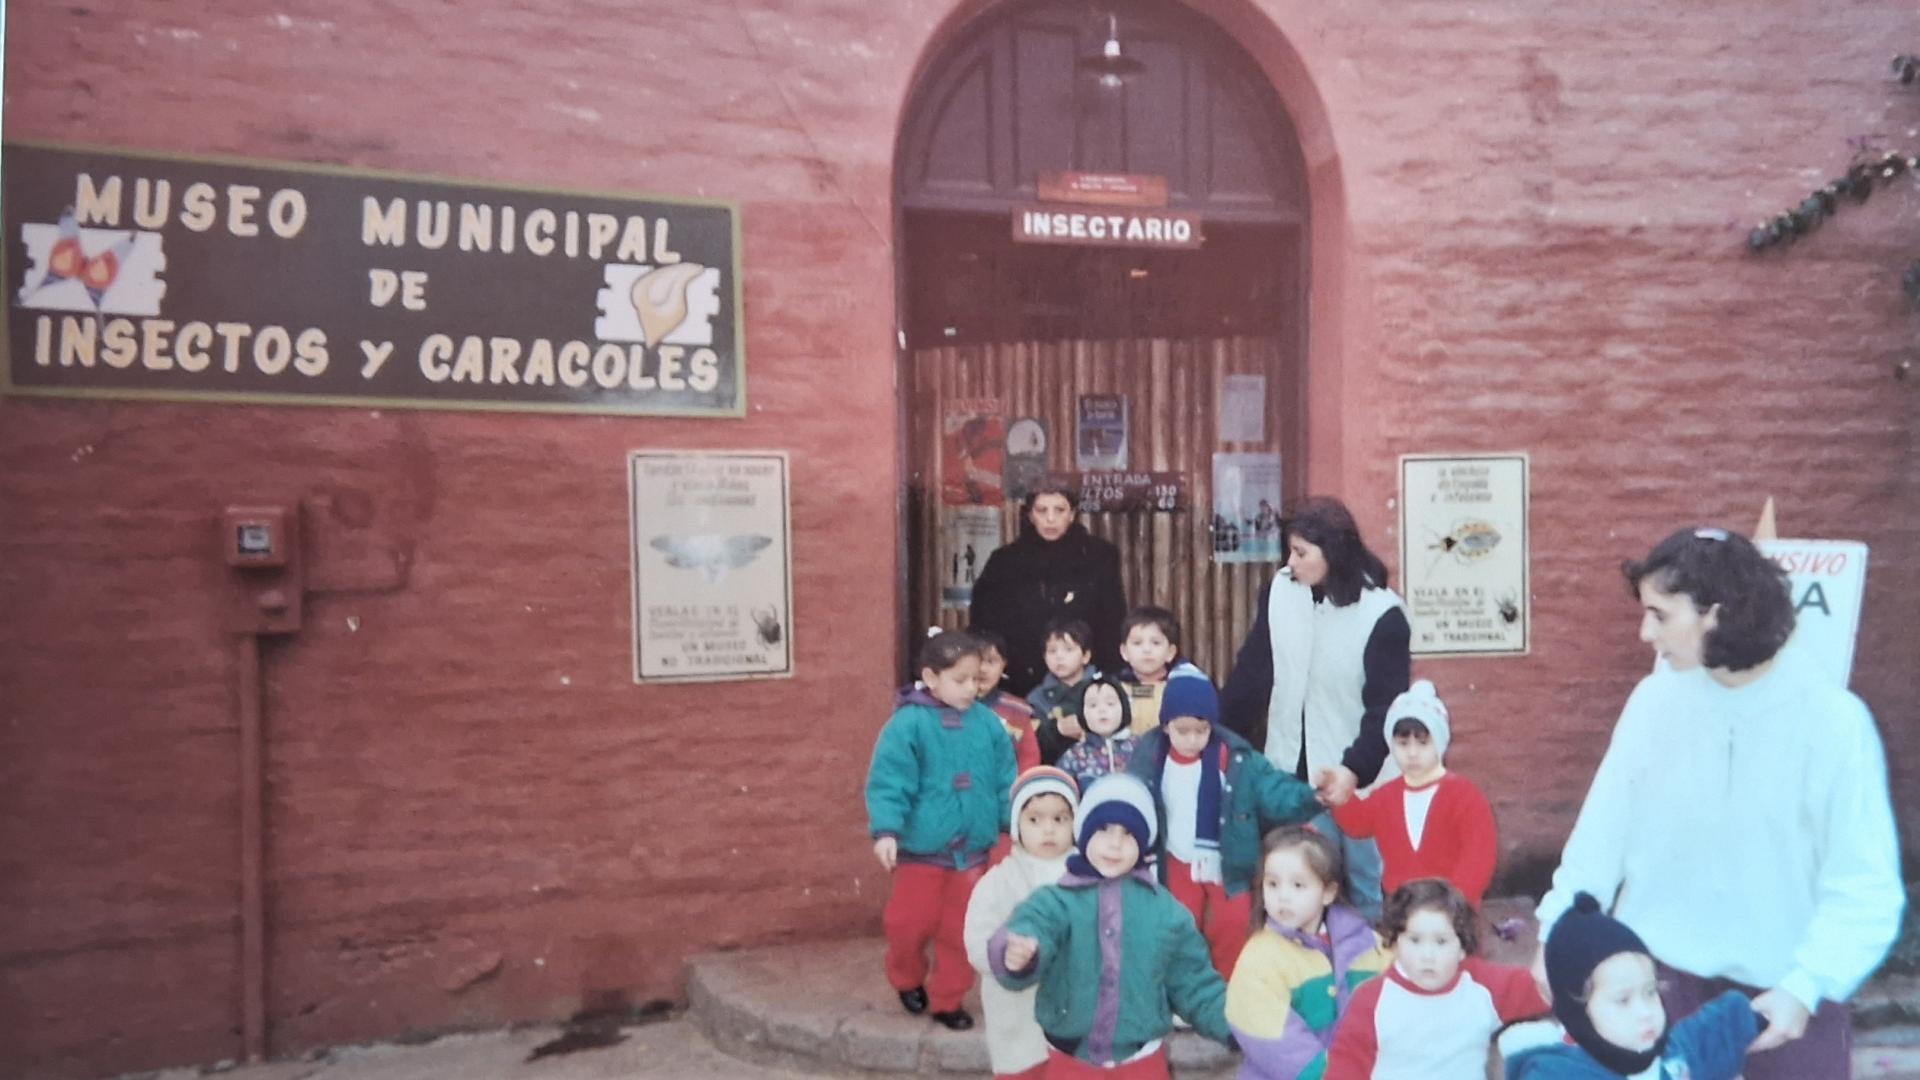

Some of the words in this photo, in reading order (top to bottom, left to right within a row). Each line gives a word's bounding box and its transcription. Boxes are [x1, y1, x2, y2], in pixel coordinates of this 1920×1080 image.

[75, 173, 307, 239] MUSEO
[362, 196, 681, 264] MUNICIPAL
[1023, 211, 1191, 241] INSECTARIO
[368, 268, 428, 310] DE
[35, 315, 330, 377] INSECTOS
[418, 333, 719, 392] CARACOLES
[1082, 473, 1152, 487] ENTRADA
